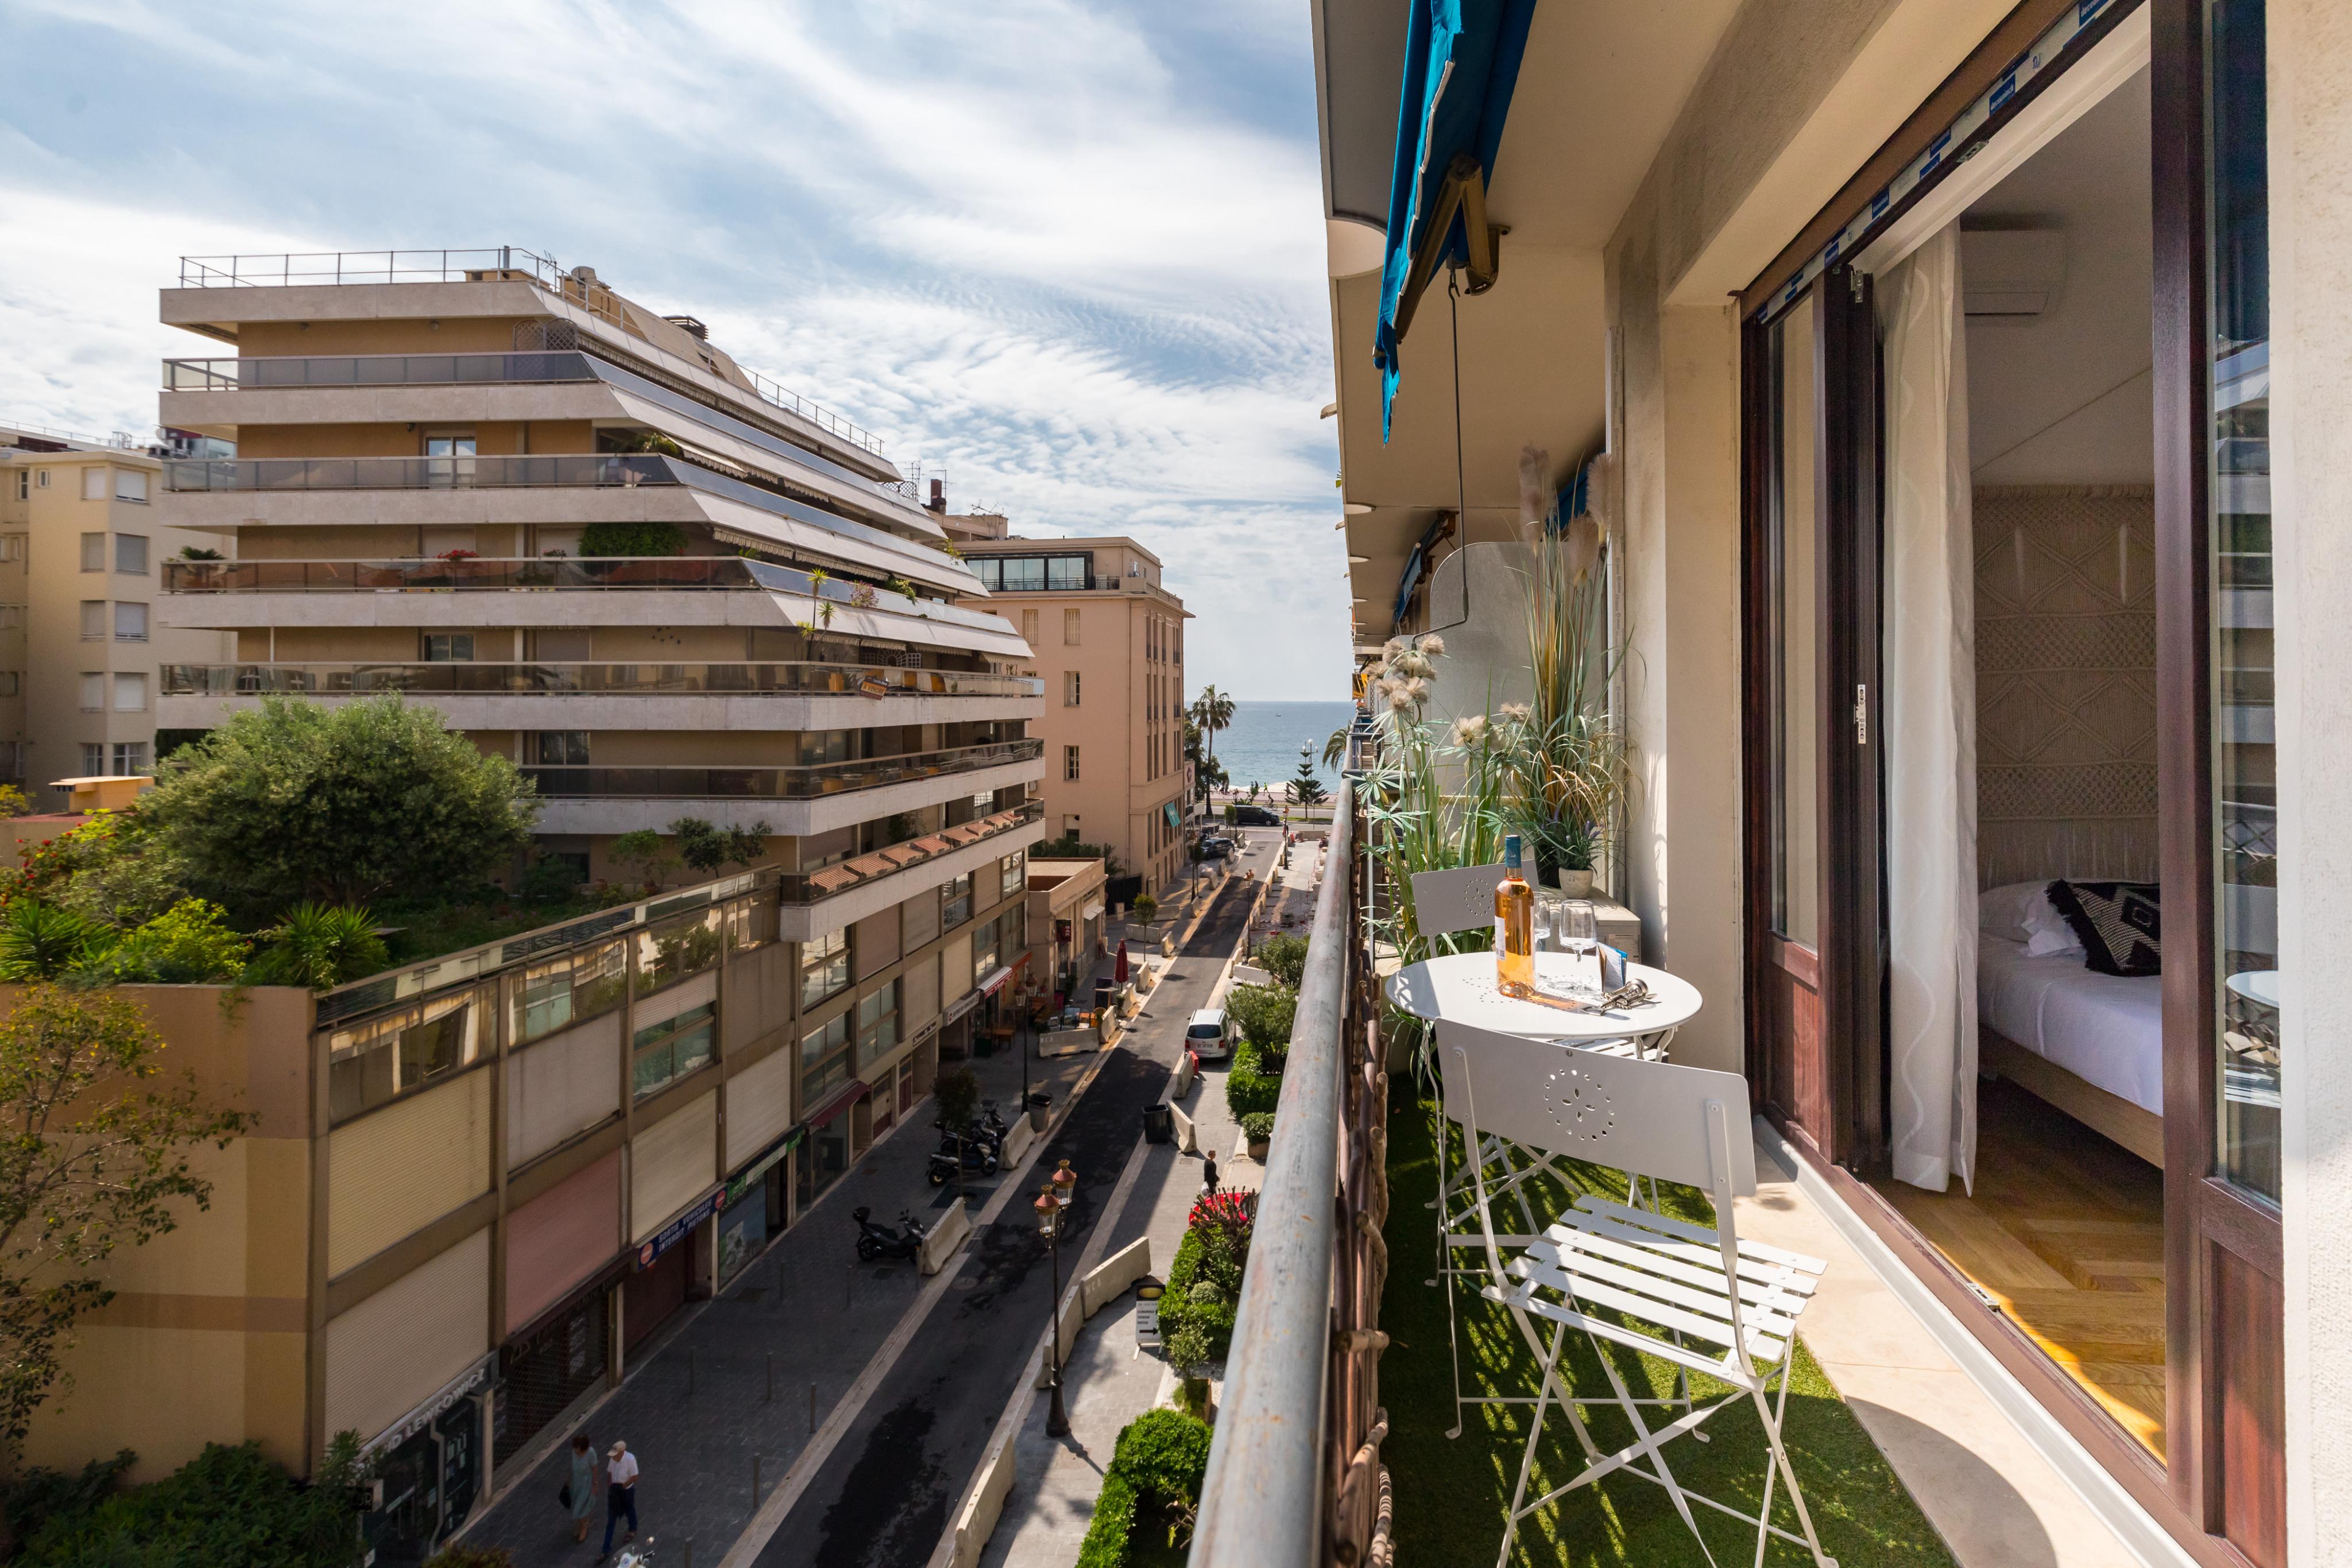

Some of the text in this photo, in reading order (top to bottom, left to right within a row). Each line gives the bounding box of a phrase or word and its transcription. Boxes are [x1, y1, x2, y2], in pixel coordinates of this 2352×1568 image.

[658, 1198, 712, 1244] SORTIE VEHICULES
[658, 1208, 711, 1253] INTERDIT PIETONS
[405, 1368, 485, 1437] LEWKOWICZ
